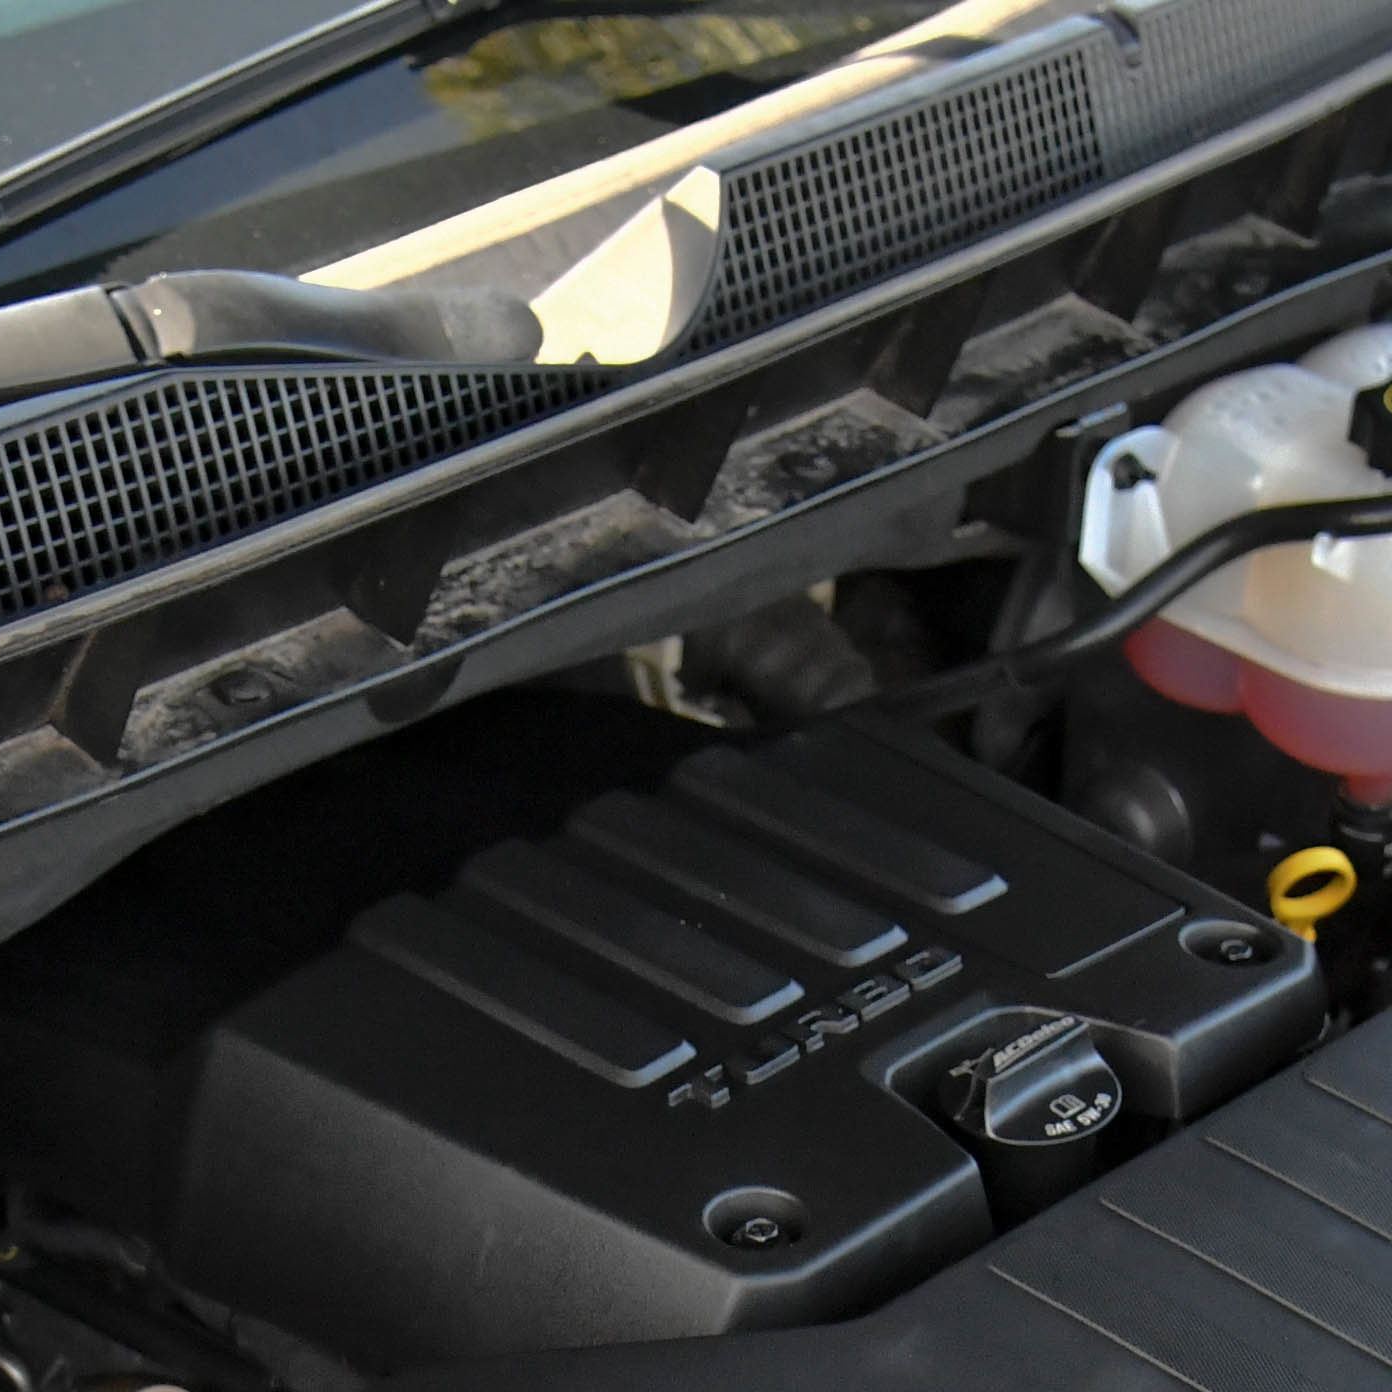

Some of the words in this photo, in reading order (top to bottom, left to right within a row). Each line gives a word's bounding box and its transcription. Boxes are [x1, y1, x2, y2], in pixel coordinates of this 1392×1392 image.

[667, 948, 964, 1109] TURBO
[992, 1015, 1076, 1074] ACDelco
[1044, 1119, 1077, 1137] SAE
